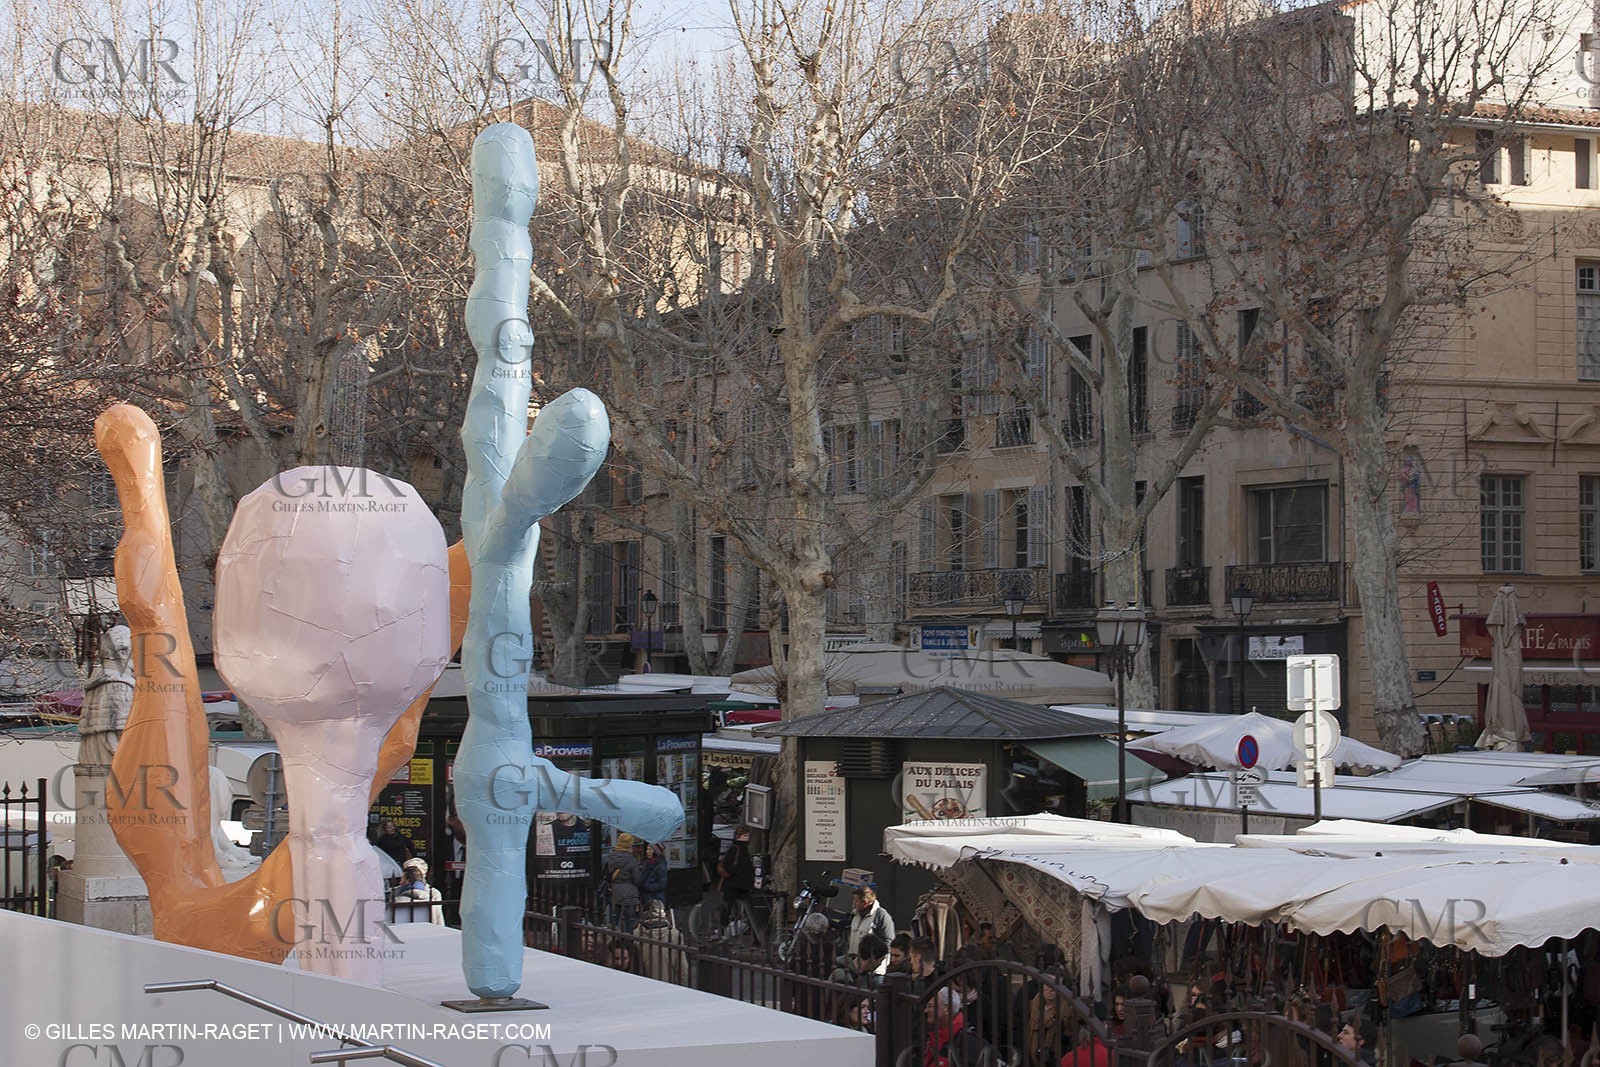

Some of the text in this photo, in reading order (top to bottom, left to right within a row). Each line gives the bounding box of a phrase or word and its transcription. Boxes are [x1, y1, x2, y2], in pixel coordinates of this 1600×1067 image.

[1431, 588, 1446, 631] TABAC
[908, 765, 981, 777] AUX DÉLICES
[915, 779, 974, 789] DU PALAIS
[380, 806, 403, 816] PLUS
